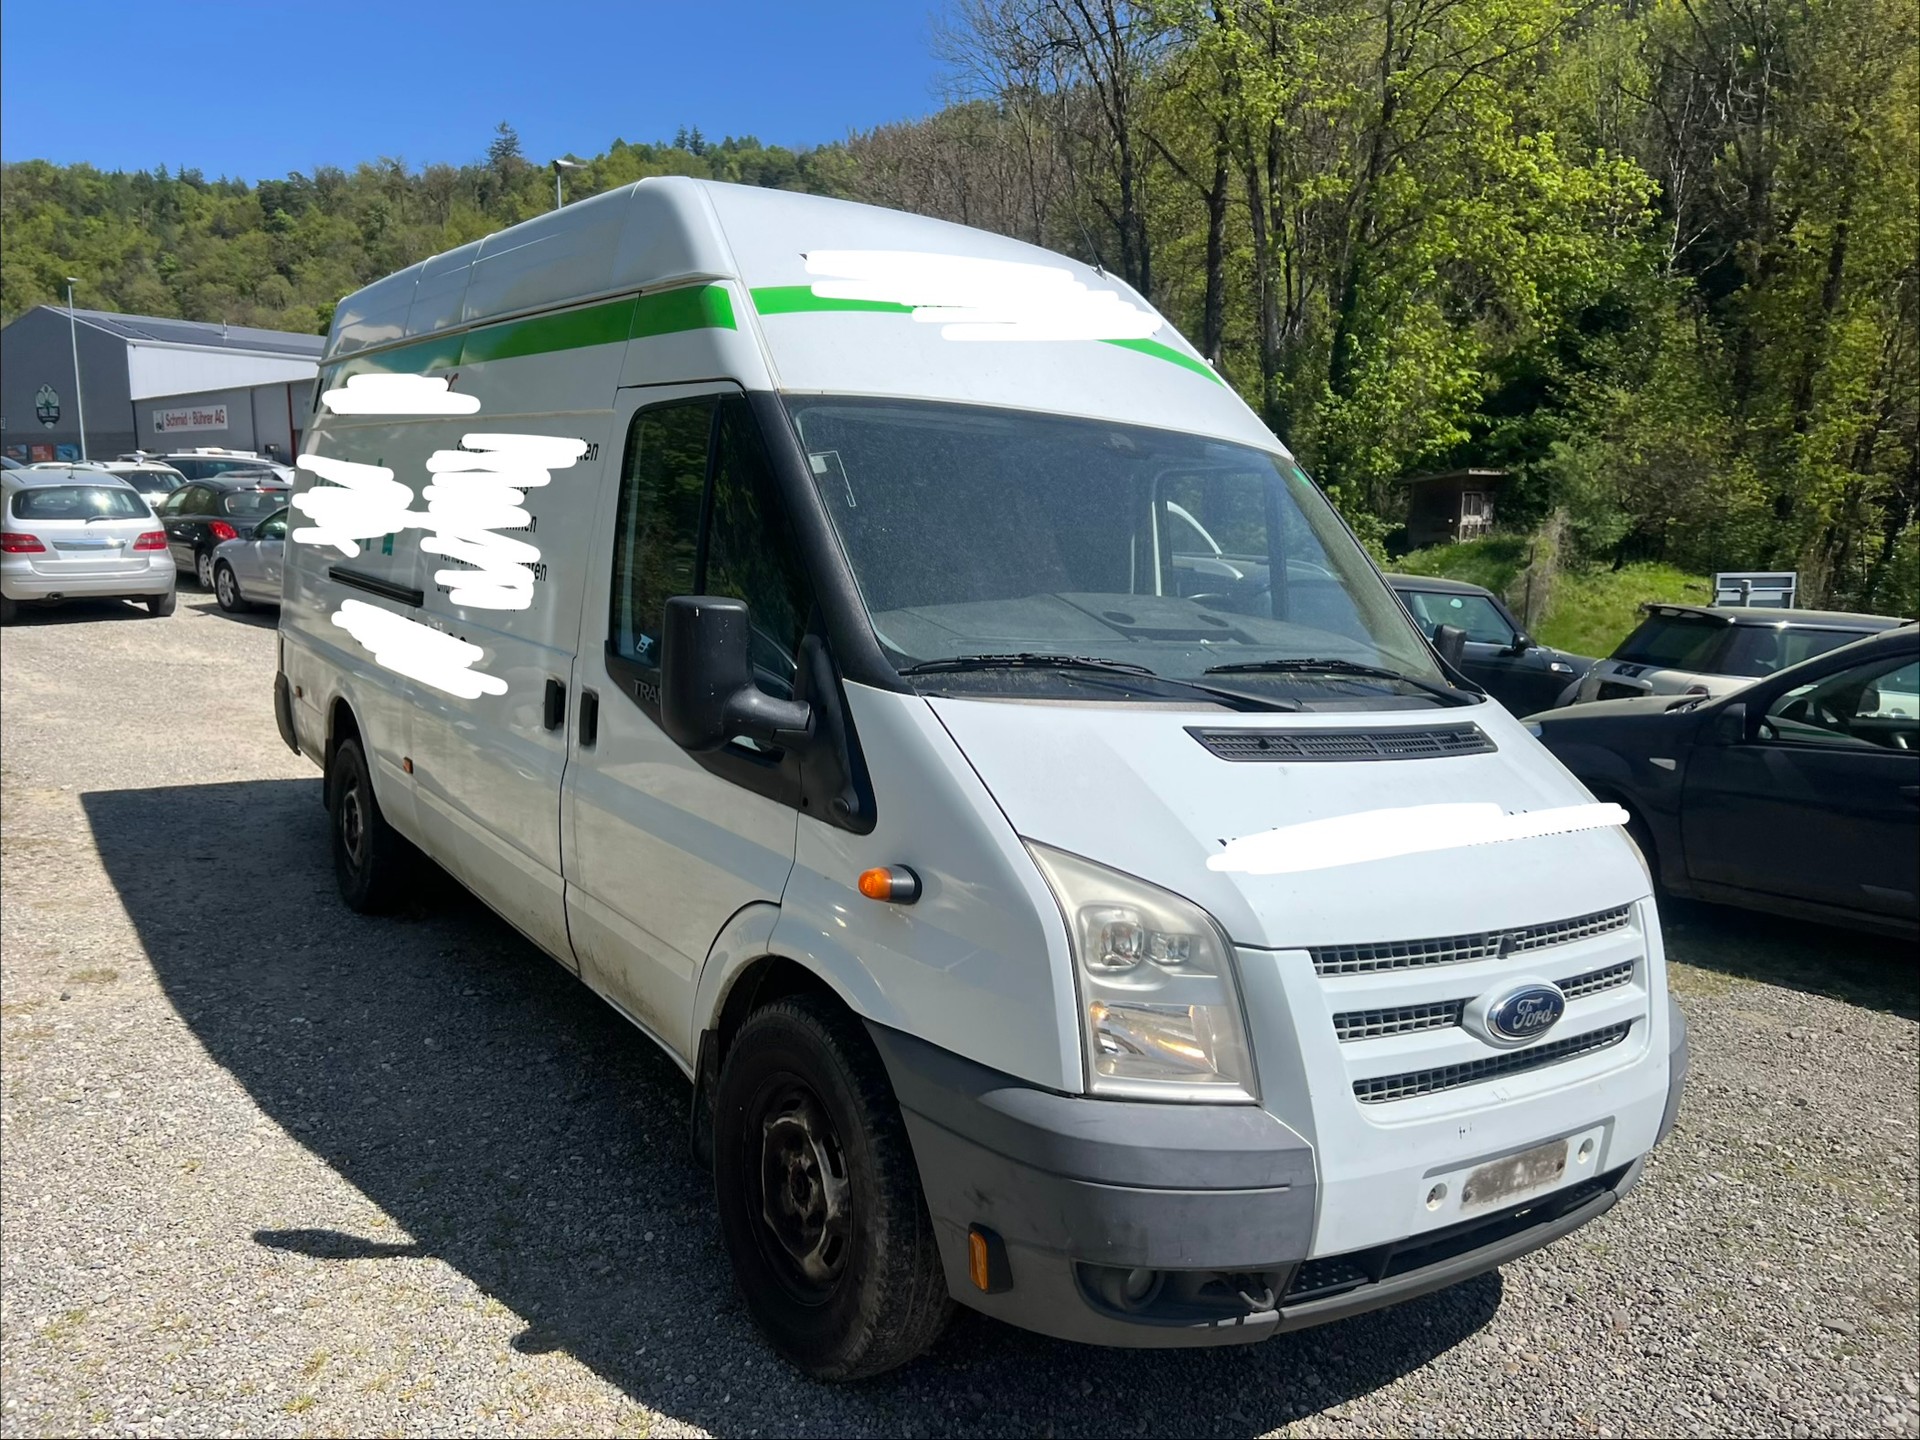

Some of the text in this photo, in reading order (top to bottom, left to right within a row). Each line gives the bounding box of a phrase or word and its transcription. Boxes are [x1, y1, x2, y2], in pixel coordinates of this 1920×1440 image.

[165, 411, 188, 427] Schmid
[192, 411, 213, 425] Bührer
[214, 409, 225, 424] AG
[1512, 997, 1554, 1030] Ford
